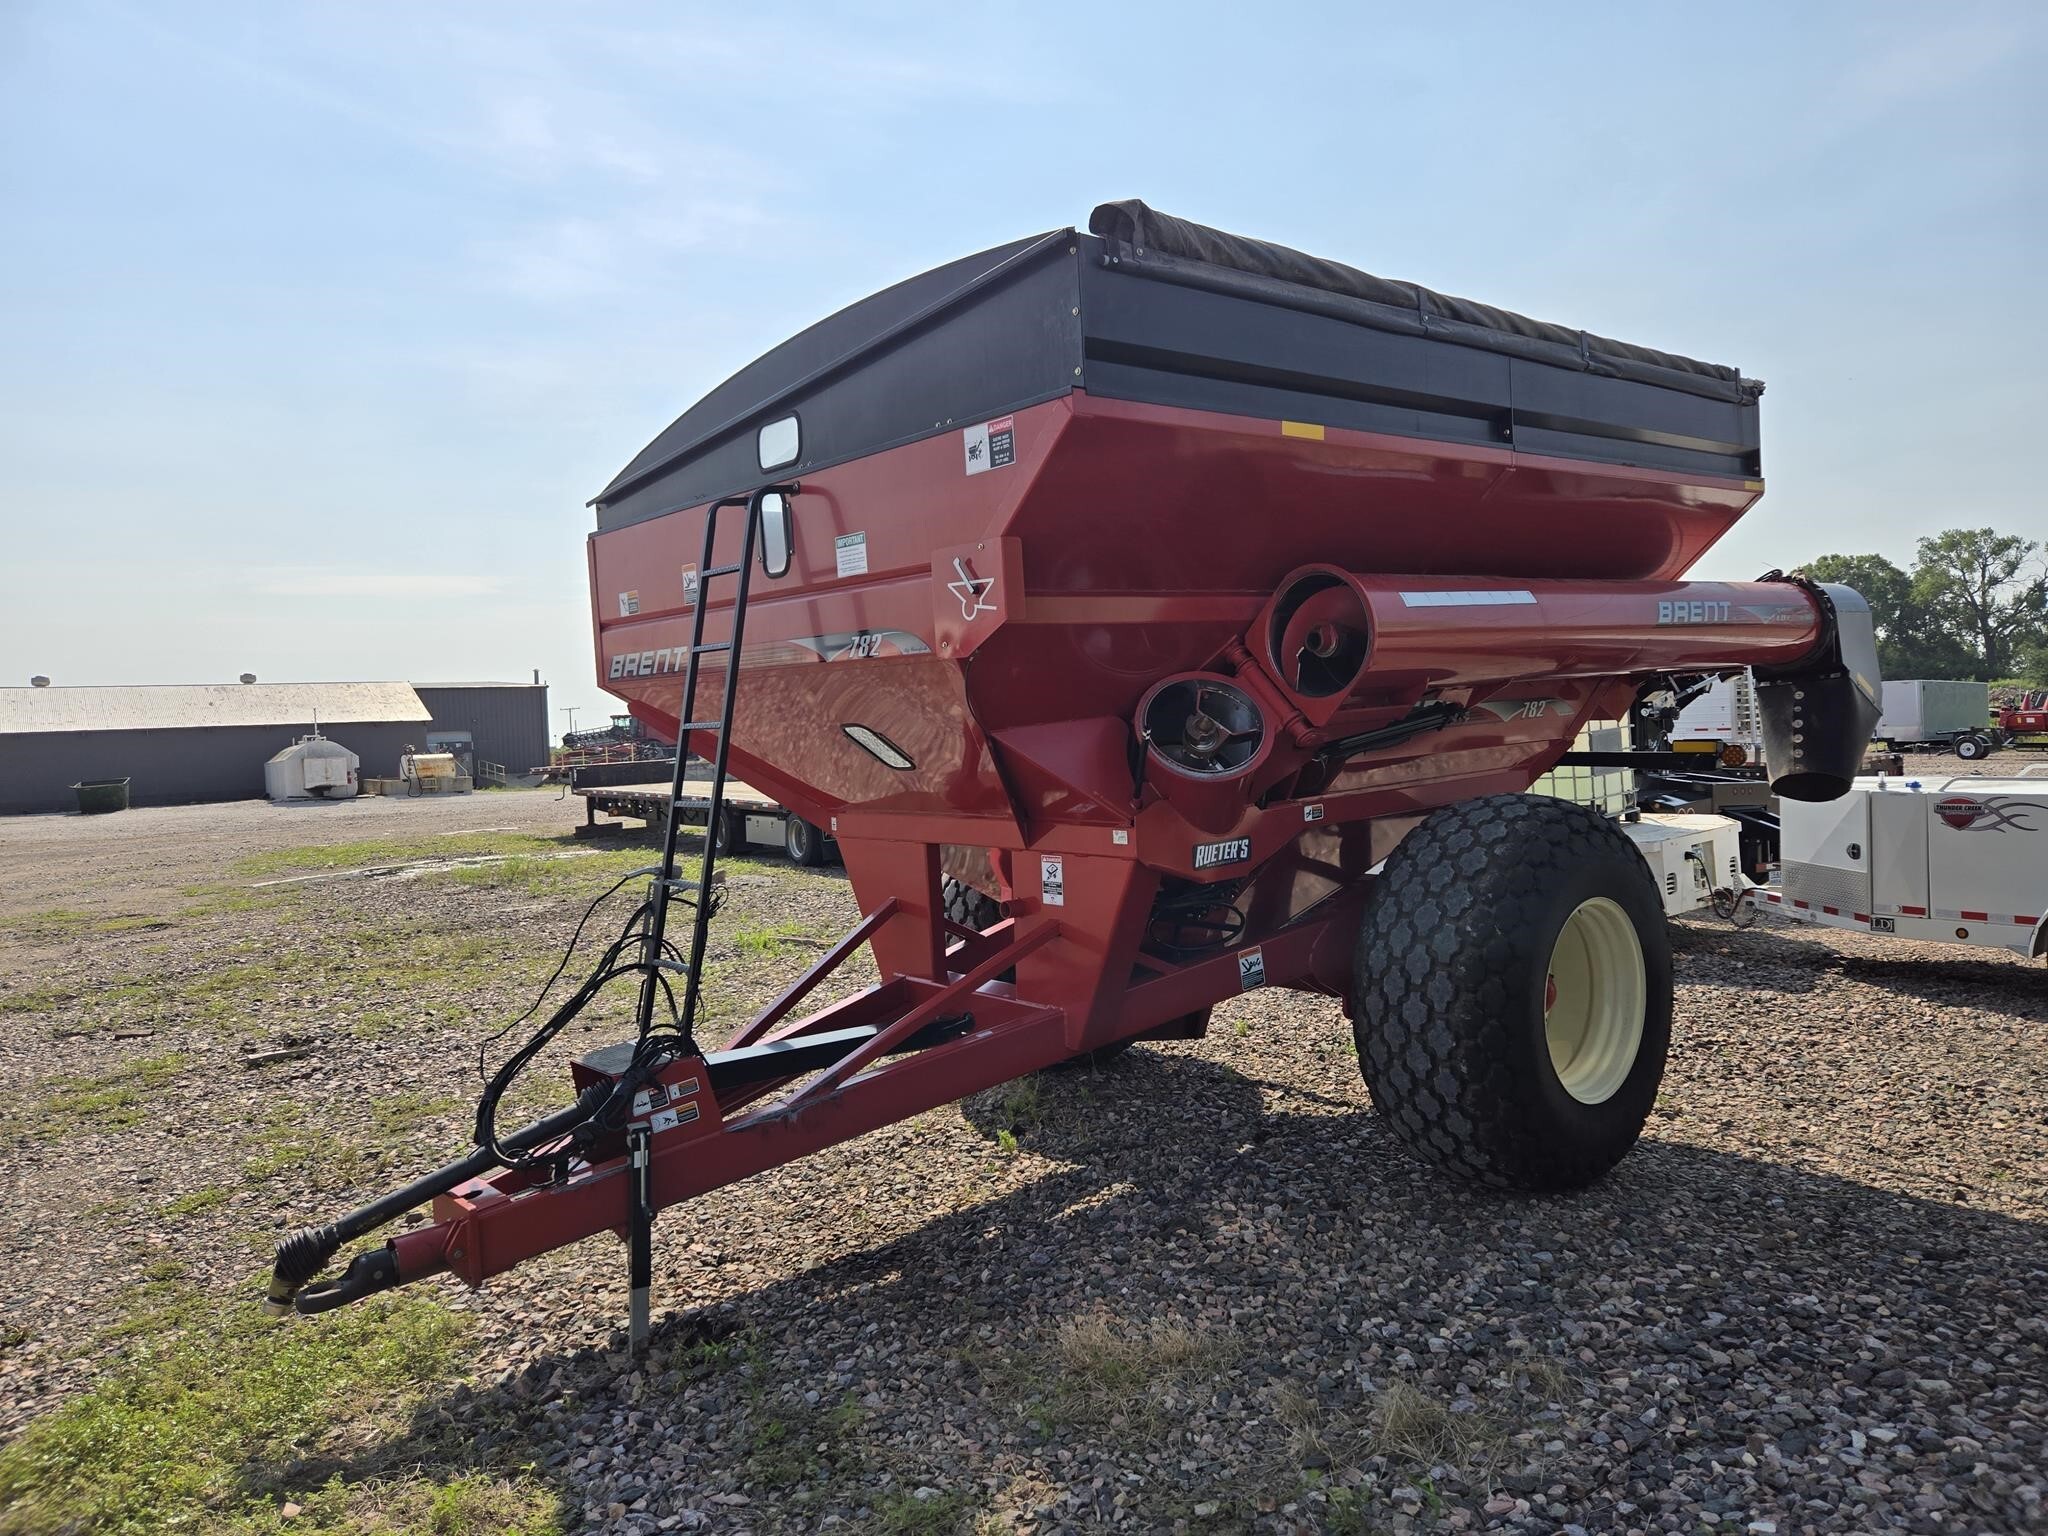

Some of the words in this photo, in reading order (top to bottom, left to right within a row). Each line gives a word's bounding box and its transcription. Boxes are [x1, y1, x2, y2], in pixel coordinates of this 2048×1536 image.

[993, 420, 1012, 430] DANGER
[836, 533, 864, 548] IMPORTANT
[1657, 600, 1731, 624] BRENT
[848, 633, 882, 658] 782
[609, 646, 689, 679] BRENT
[1521, 700, 1546, 719] 782
[1194, 838, 1249, 868] RUETER'S
[1872, 918, 1893, 932] LDJ
